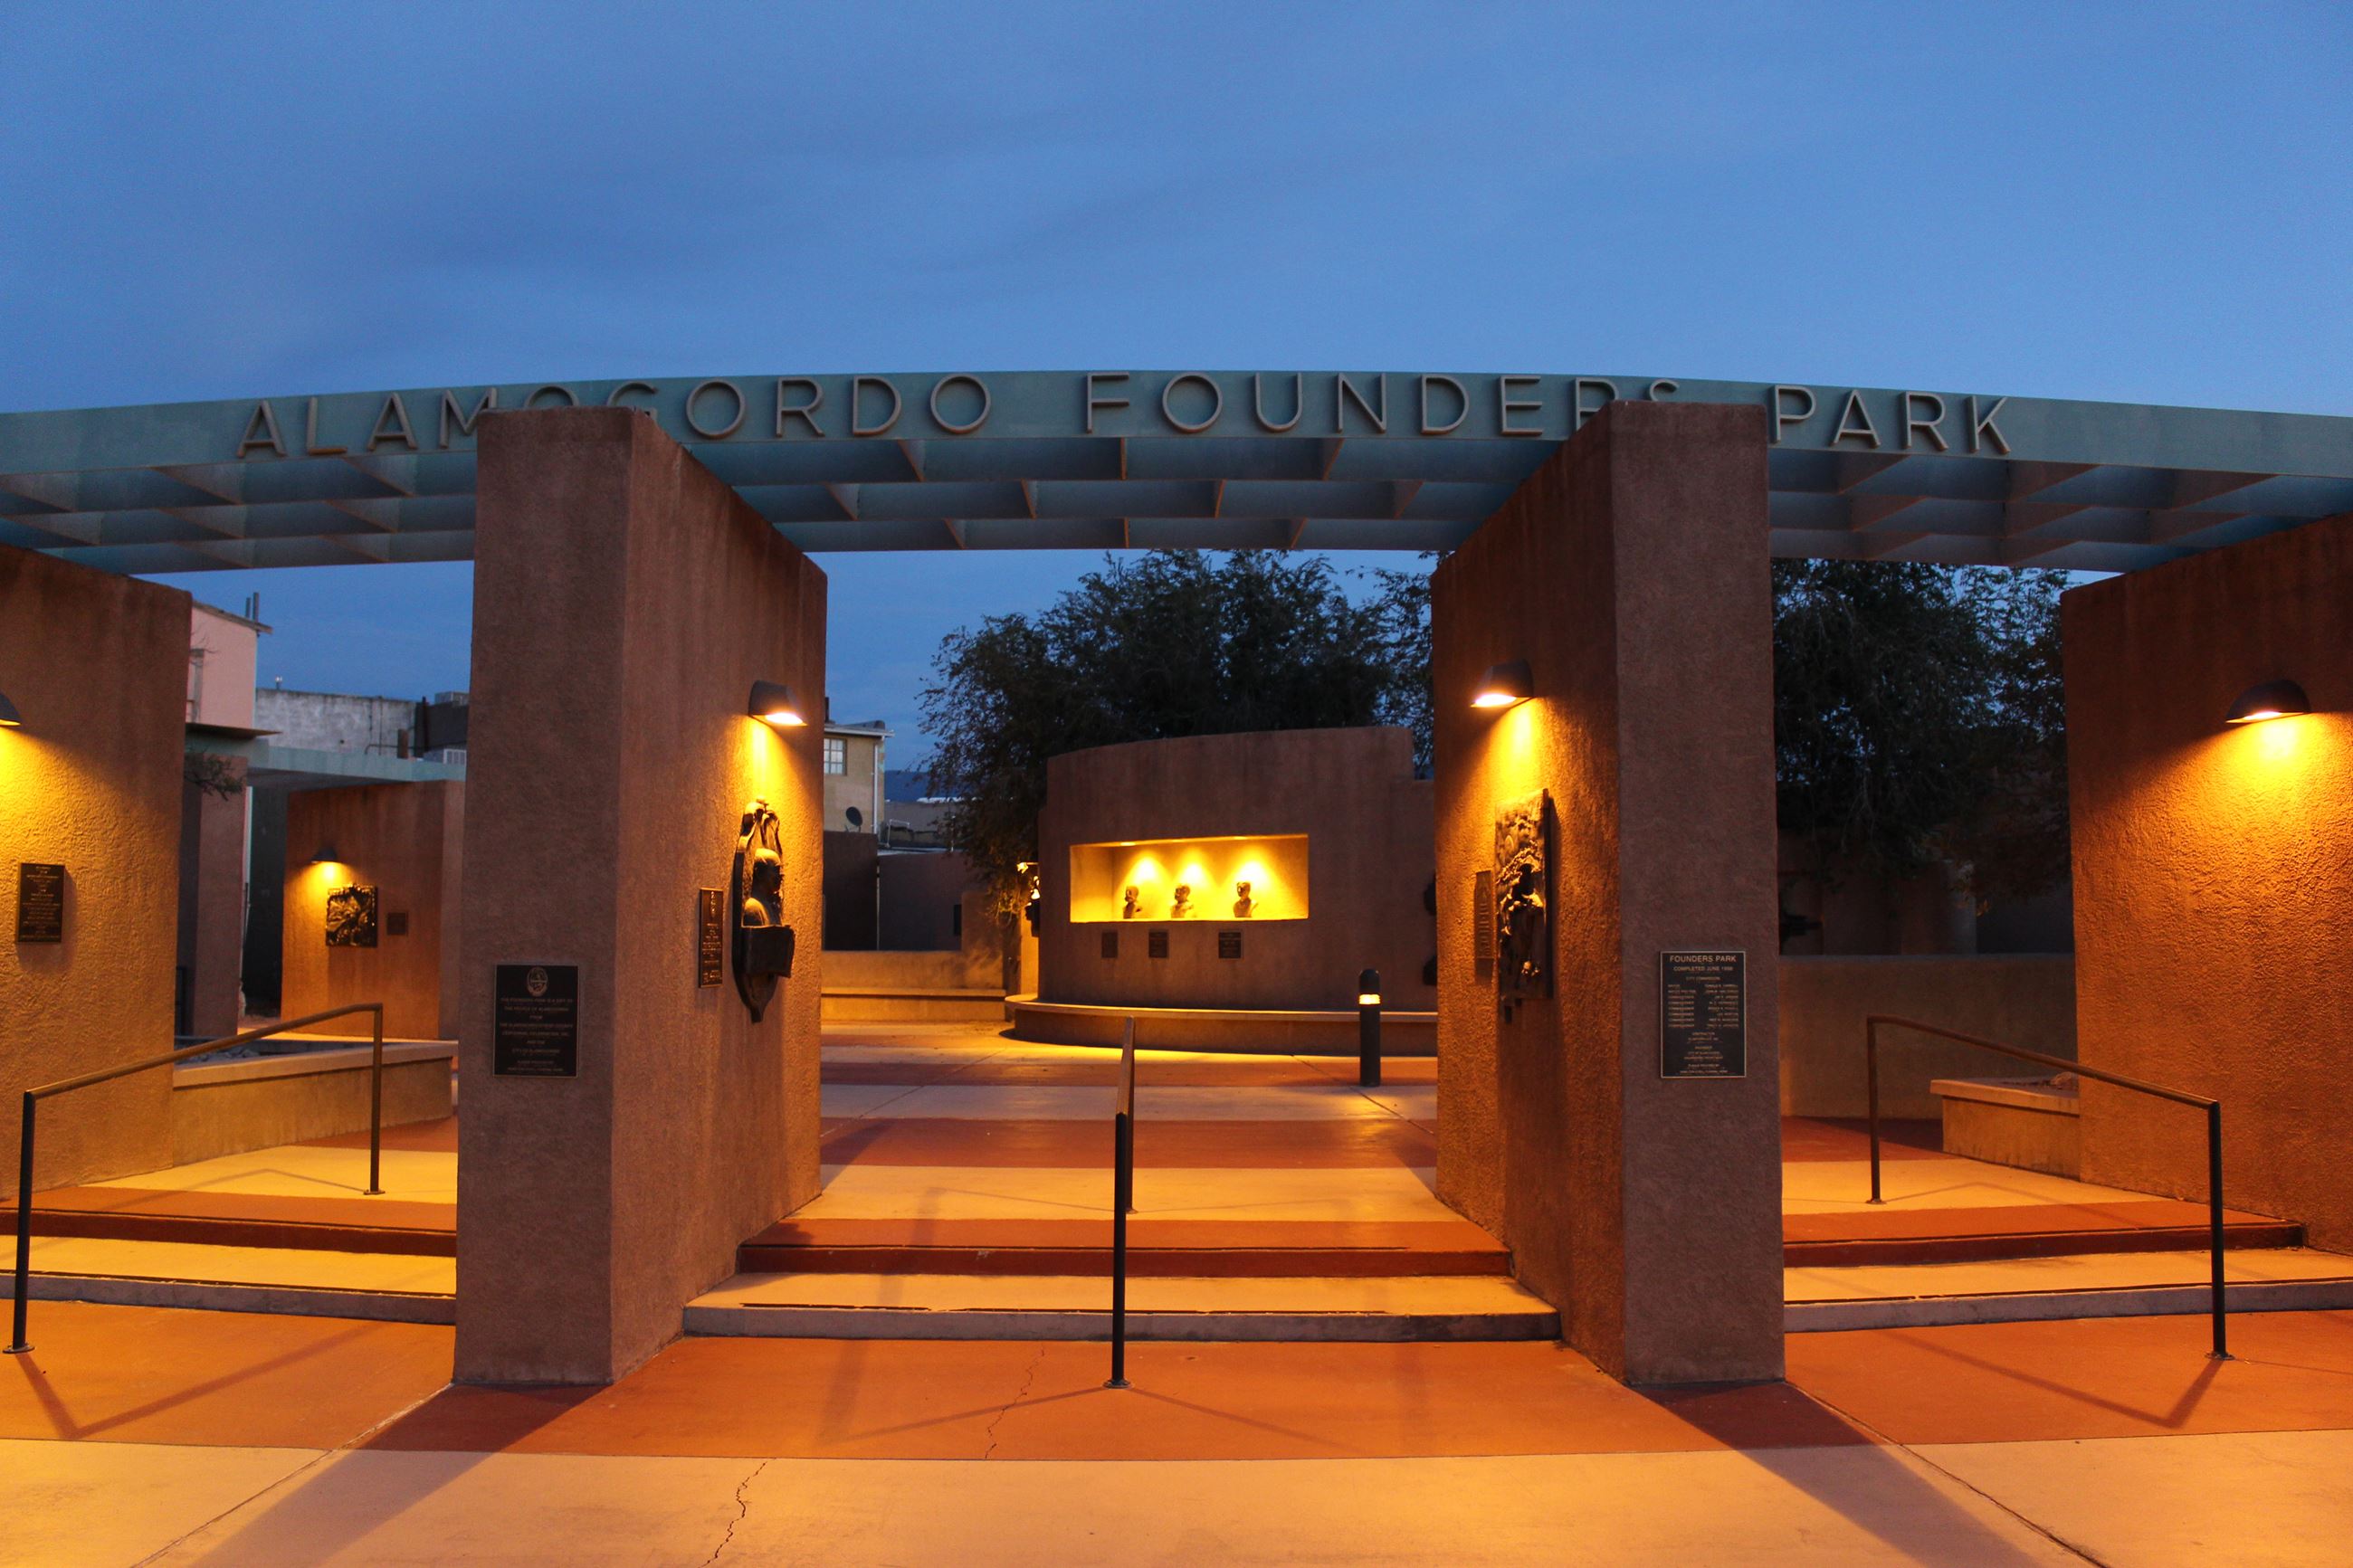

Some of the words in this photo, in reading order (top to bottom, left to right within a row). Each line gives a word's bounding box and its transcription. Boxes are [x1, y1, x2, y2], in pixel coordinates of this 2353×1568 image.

[1772, 384, 2012, 455] PARK
[1670, 955, 1714, 963] FOUNDERS
[1715, 955, 1737, 963] PARK
